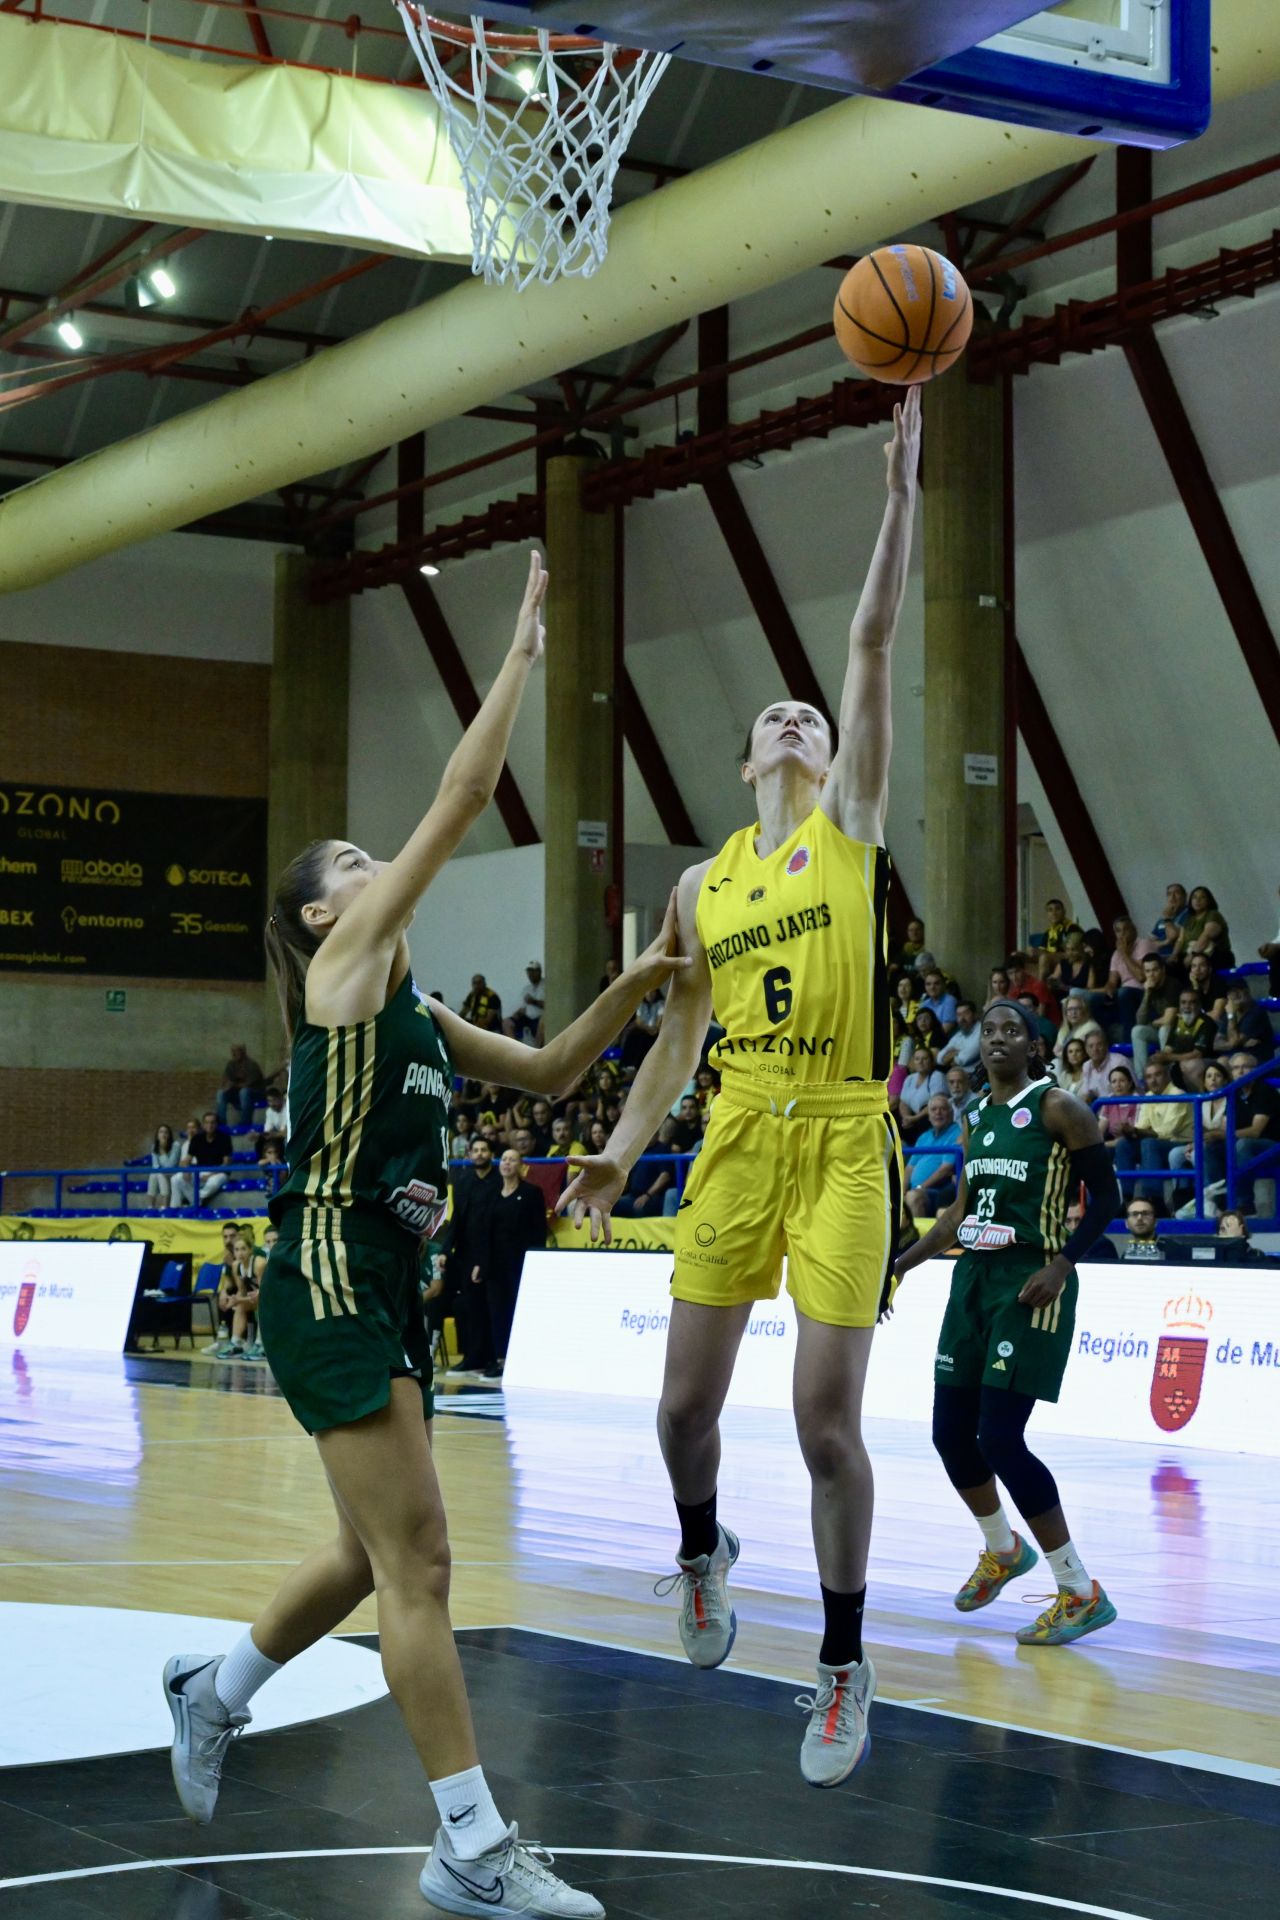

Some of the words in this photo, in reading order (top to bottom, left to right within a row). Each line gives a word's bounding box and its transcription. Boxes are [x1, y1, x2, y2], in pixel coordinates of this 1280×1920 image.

[188, 869, 252, 887] SOTECA
[78, 914, 144, 929] entorno
[707, 924, 771, 970] HOZONO
[776, 902, 832, 942] JAIRIS
[762, 965, 794, 1026] 6
[976, 1188, 997, 1218] 23
[620, 1309, 669, 1335] Región
[744, 1315, 786, 1337] urcia
[1078, 1331, 1149, 1363] Región
[1216, 1338, 1243, 1365] de
